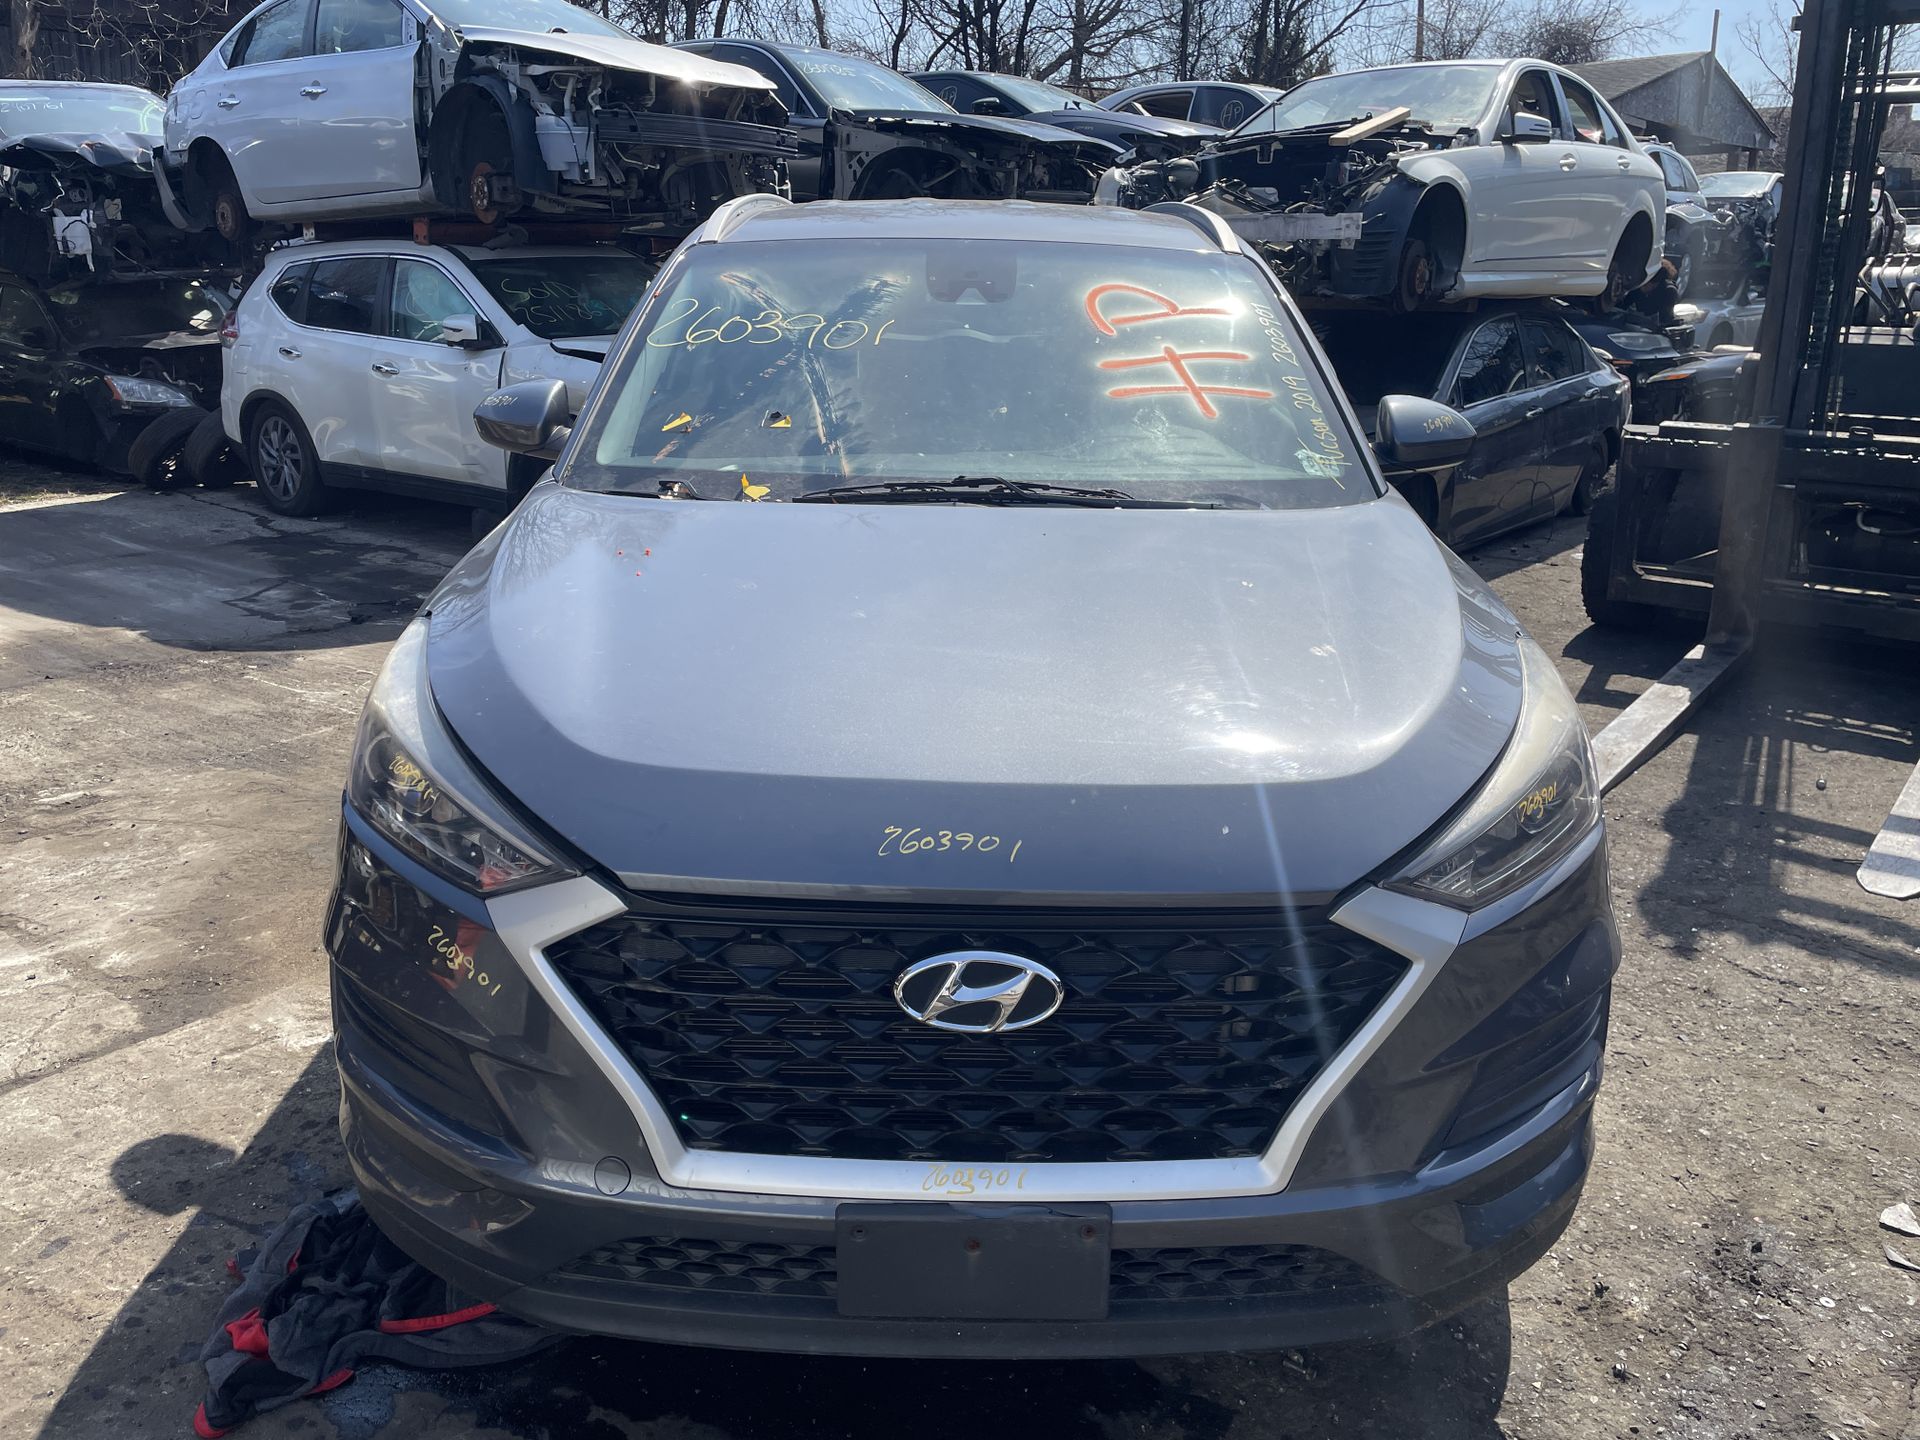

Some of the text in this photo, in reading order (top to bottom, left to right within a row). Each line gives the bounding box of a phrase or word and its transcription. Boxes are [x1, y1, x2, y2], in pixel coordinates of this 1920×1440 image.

[646, 298, 895, 350] 2603901
[1250, 302, 1299, 367] 2603901
[1281, 376, 1322, 413] 2019
[878, 825, 1022, 863] 2603901
[427, 925, 502, 996] 2603901
[922, 1165, 1028, 1194] 2603901
